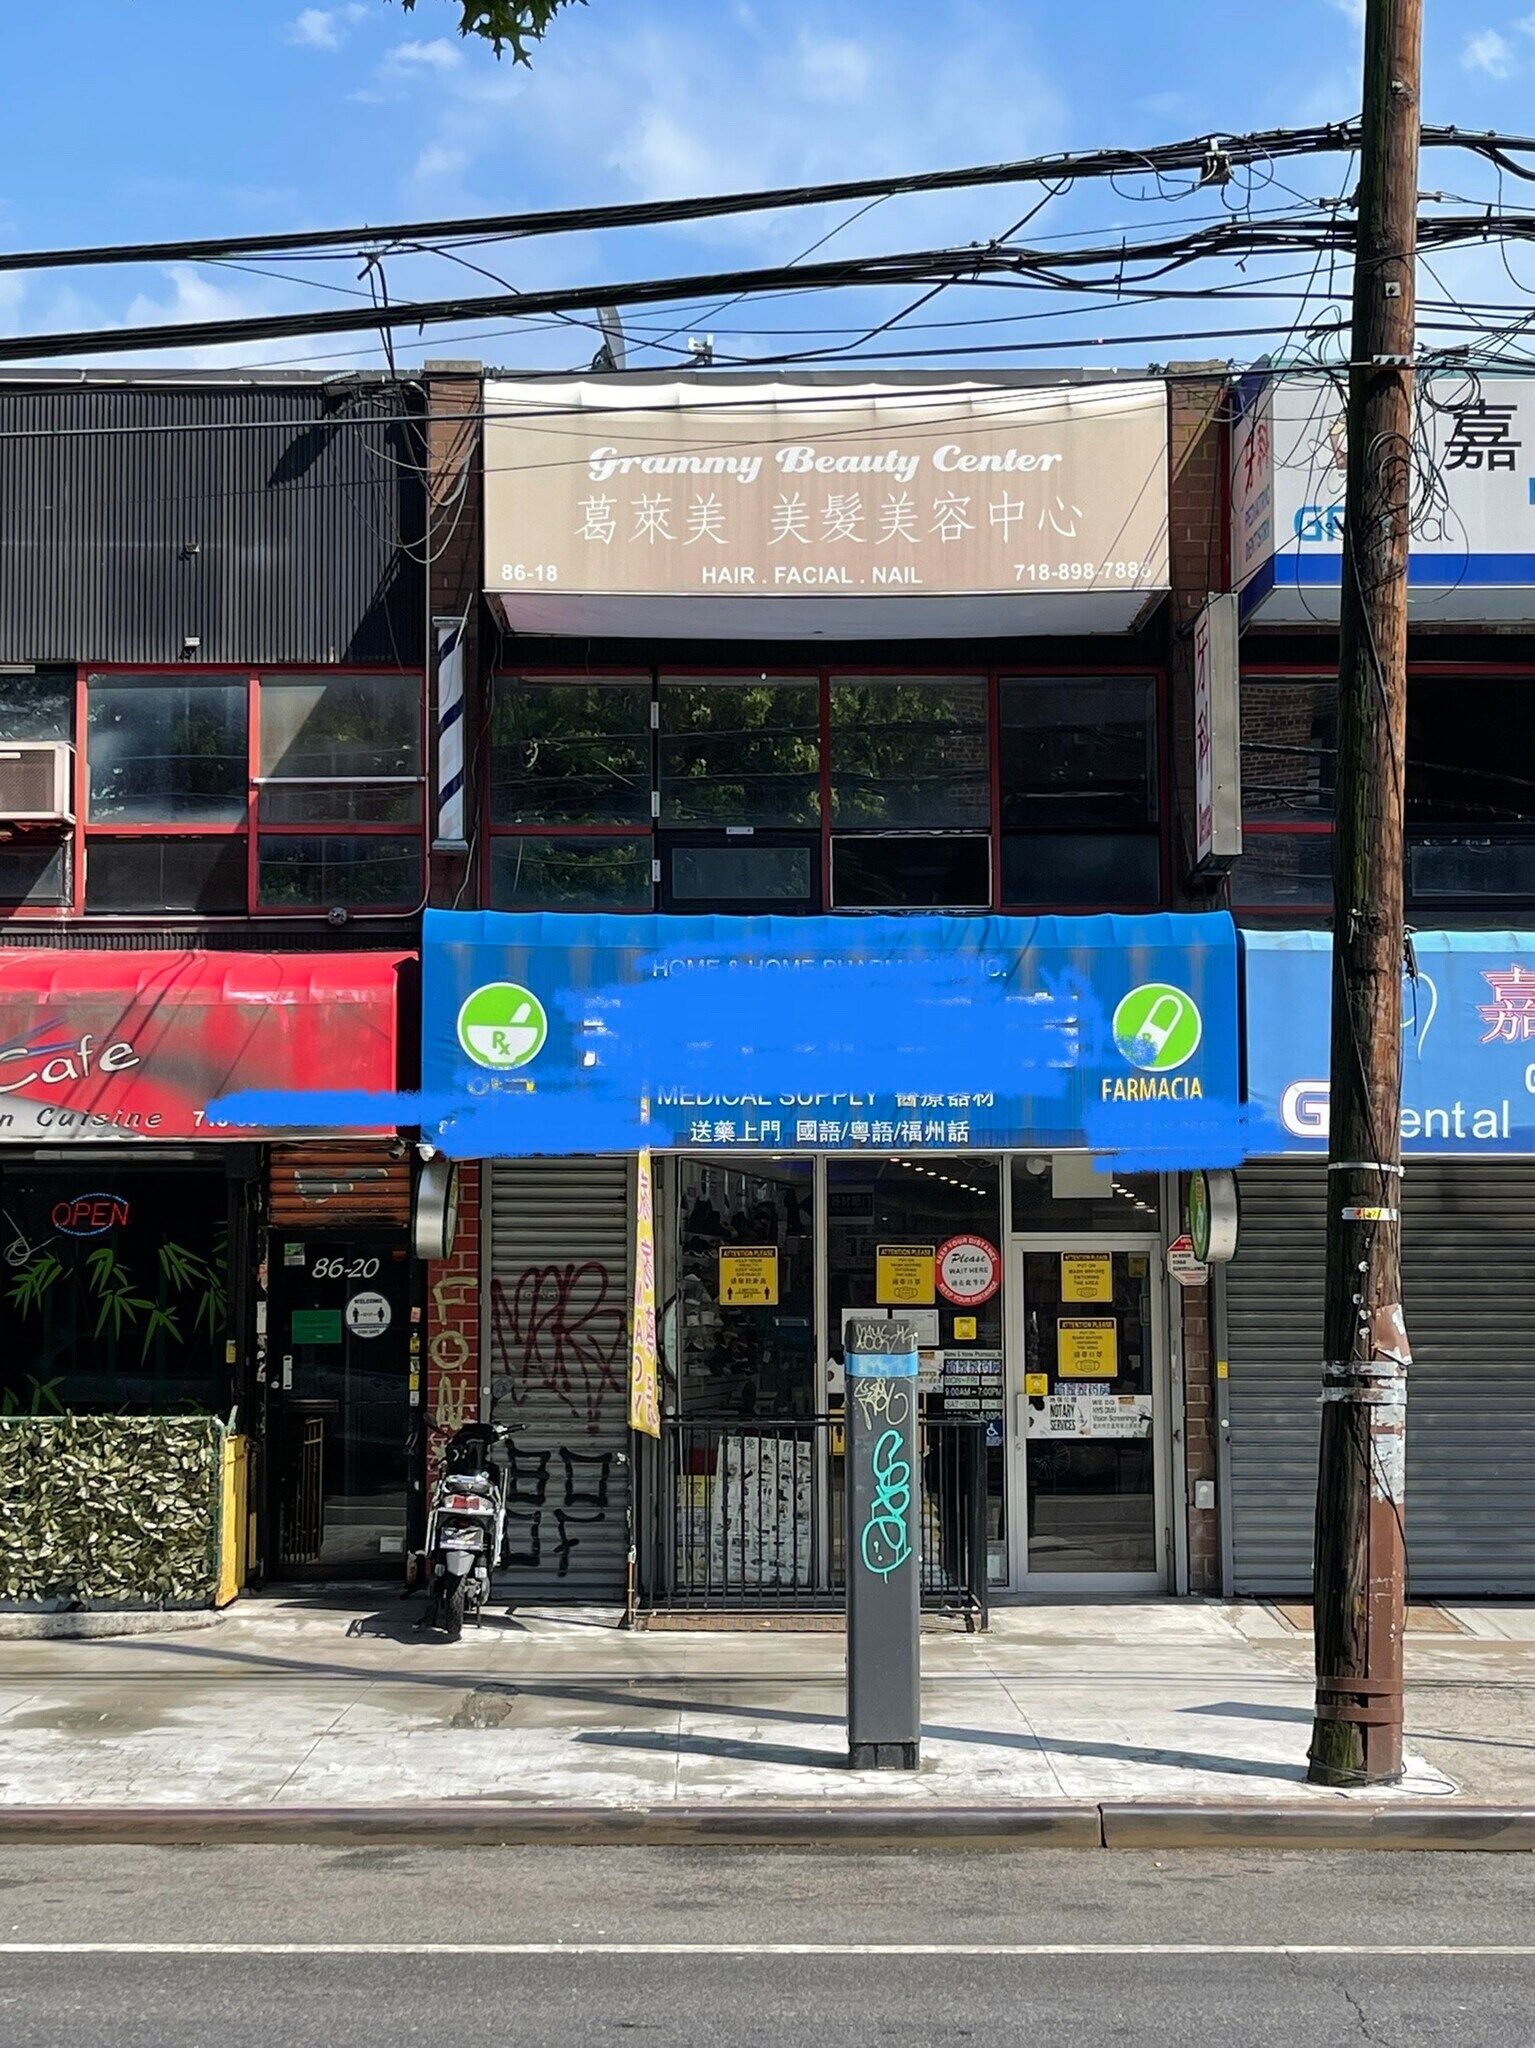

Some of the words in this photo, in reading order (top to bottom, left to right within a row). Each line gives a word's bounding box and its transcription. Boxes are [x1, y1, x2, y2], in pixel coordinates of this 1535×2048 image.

[1444, 399, 1522, 471] 嘉
[588, 445, 763, 483] Grammy
[775, 445, 920, 482] Beauty
[932, 444, 1063, 474] Center
[574, 491, 727, 546] 葛萊美
[768, 490, 1084, 546] 美髮美容中心
[501, 563, 558, 582] 86-18
[702, 566, 755, 584] HAIR
[774, 566, 854, 583] FACIAL
[872, 565, 923, 583] NAIL
[1102, 1076, 1203, 1102] FARMACIA
[37, 1108, 163, 1128] Cuisine
[1400, 1101, 1511, 1139] ental
[690, 1120, 782, 1143] 送藥上門
[52, 1202, 130, 1226] OPEN
[312, 1257, 380, 1279] 86-20
[951, 1252, 986, 1263] Please
[1050, 1404, 1076, 1418] NOTARY
[1050, 1419, 1076, 1431] SERVICES
